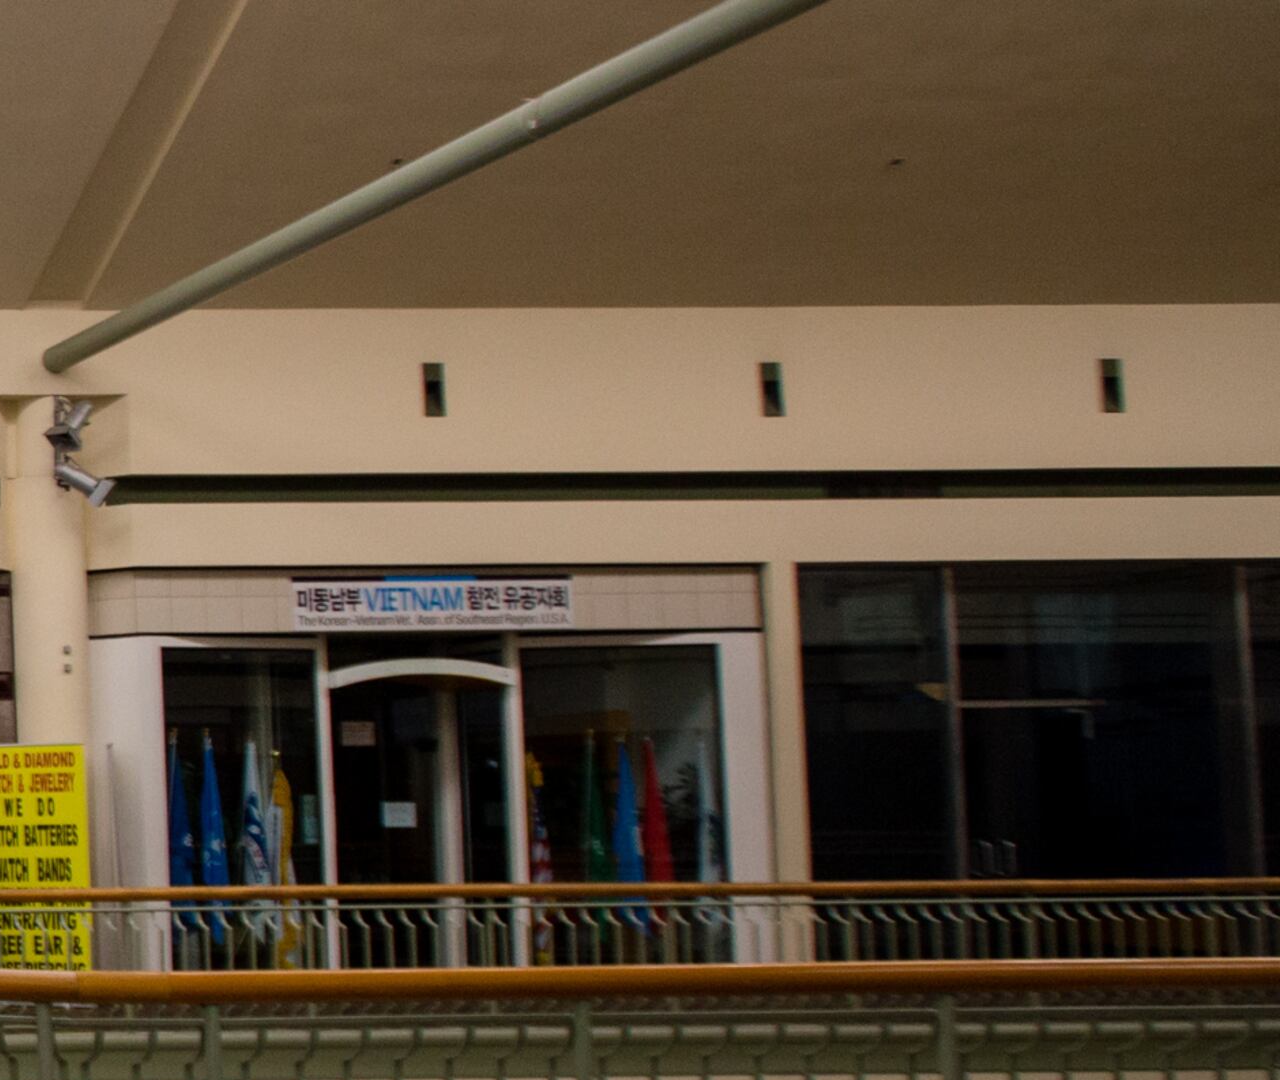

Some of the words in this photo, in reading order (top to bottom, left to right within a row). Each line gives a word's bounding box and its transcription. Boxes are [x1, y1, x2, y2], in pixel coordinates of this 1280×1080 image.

[363, 587, 464, 612] VIETNAM
[13, 753, 21, 769] &
[24, 752, 76, 769] DIAMOND
[30, 772, 76, 793] JEWELERY
[4, 798, 23, 818] WE
[37, 797, 55, 817] DO
[23, 824, 79, 847] BATTERIES
[37, 857, 73, 883] BANDS
[73, 936, 83, 955] &
